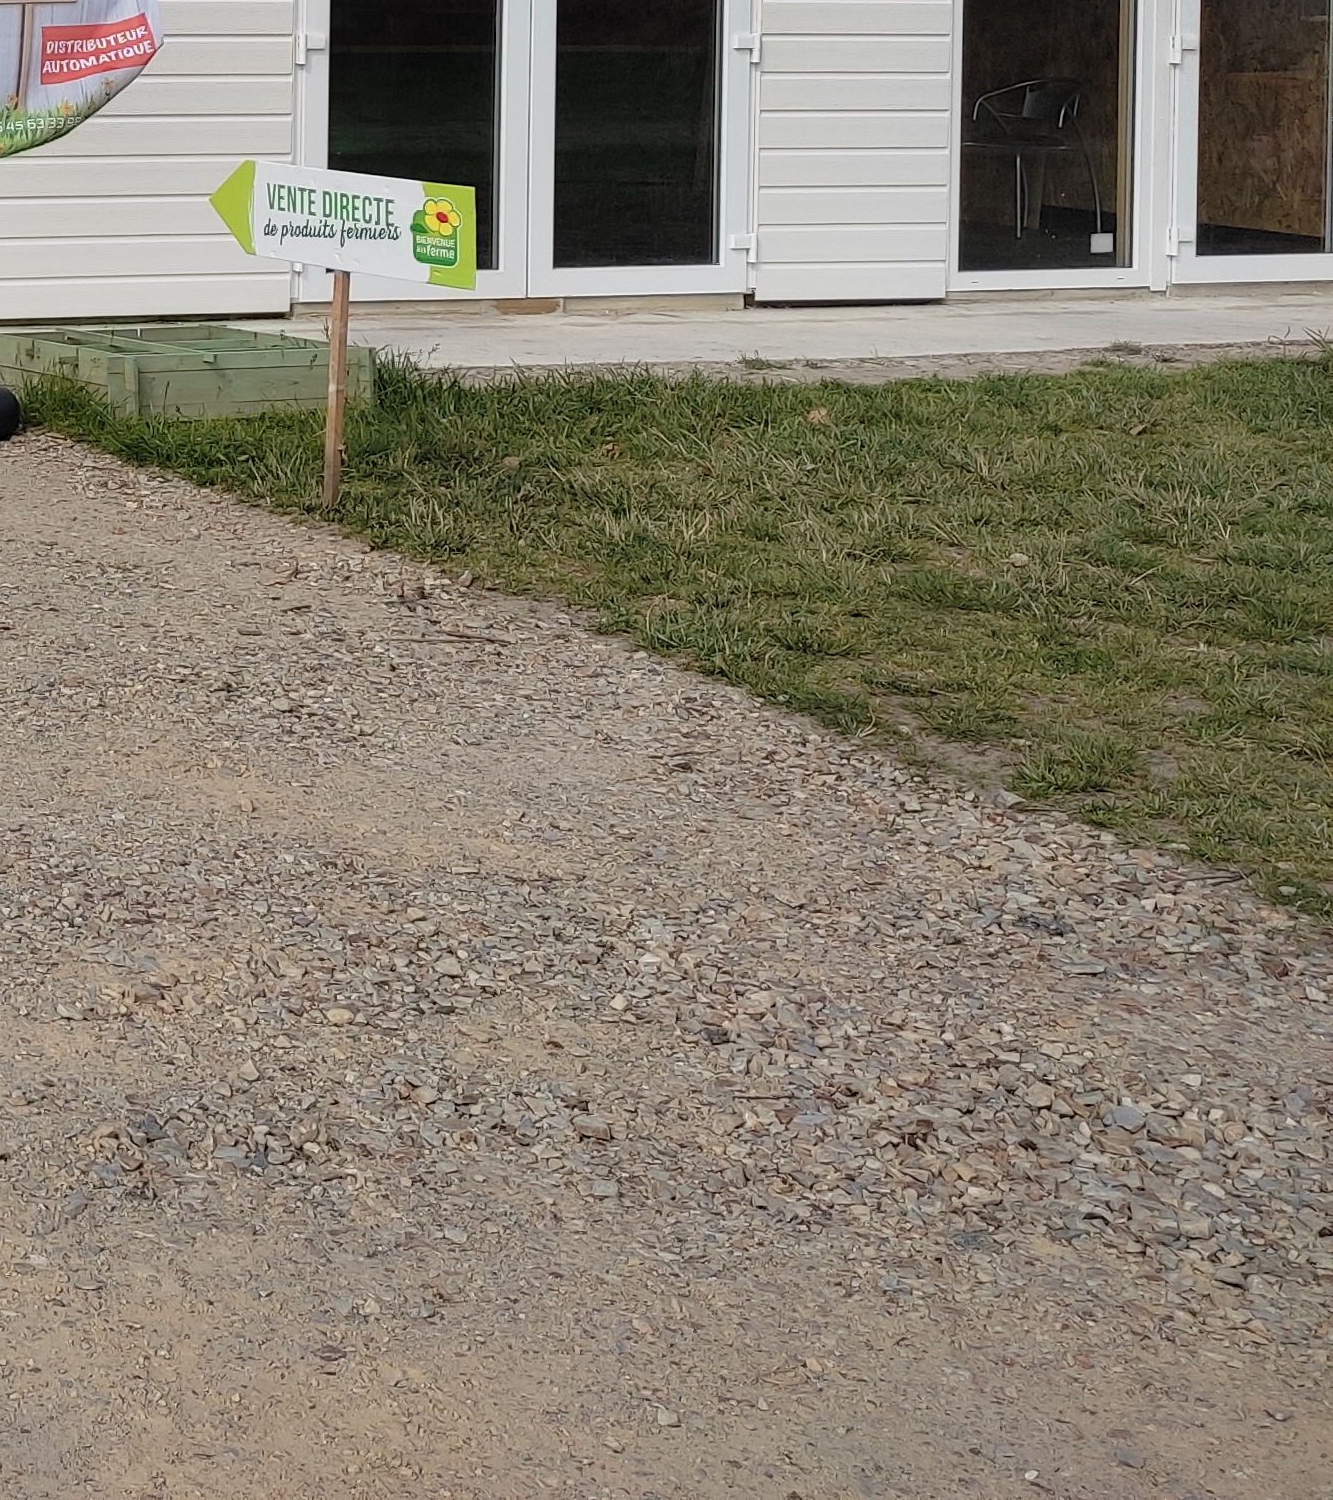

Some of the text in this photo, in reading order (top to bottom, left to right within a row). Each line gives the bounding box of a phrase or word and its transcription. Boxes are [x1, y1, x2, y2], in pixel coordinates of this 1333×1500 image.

[46, 25, 148, 54] DISTRIBUTEUR
[42, 40, 155, 74] AUTOMATIQUE
[6, 120, 24, 131] 45
[266, 182, 395, 227] VENTE DIRECTE
[263, 218, 402, 248] de produits fermiers
[415, 235, 455, 248] BIENVENUE
[426, 245, 455, 259] ferme
